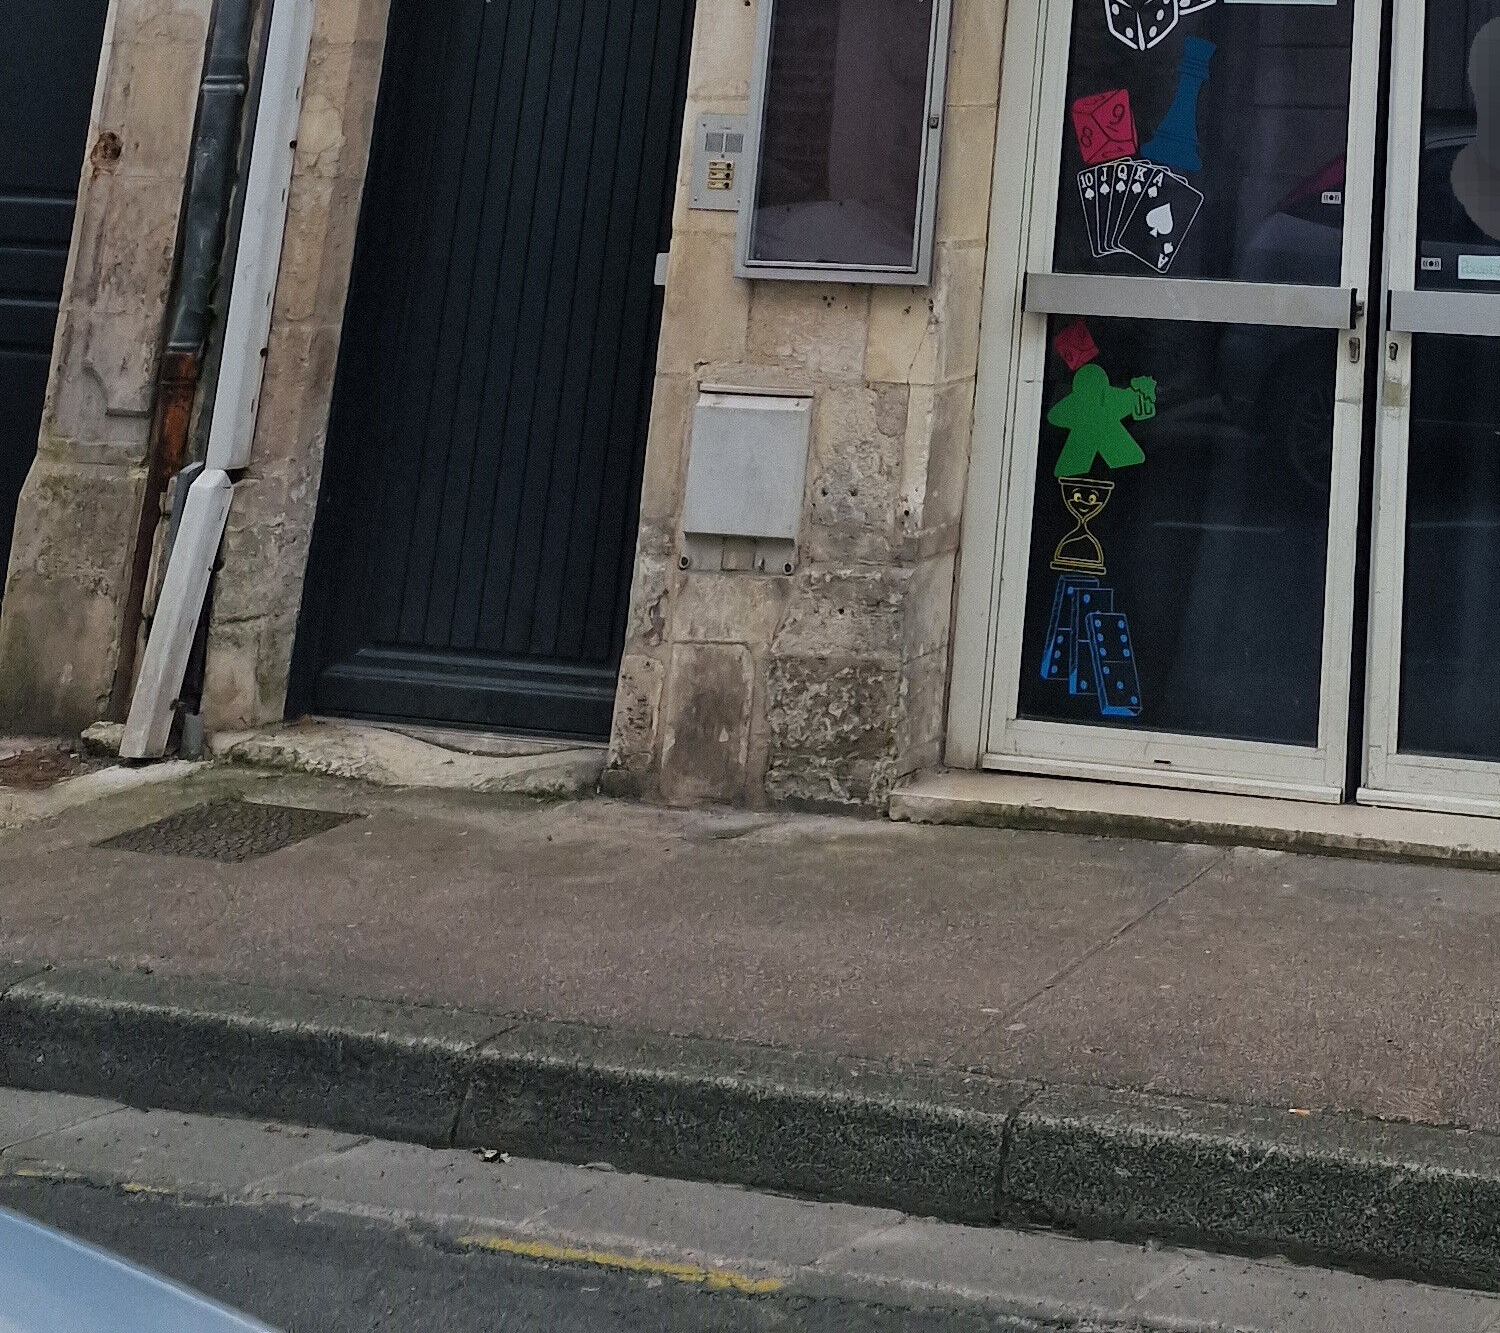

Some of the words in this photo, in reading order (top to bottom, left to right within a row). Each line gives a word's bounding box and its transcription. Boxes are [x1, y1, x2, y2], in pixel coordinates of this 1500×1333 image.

[1080, 173, 1094, 189] 10
[1100, 167, 1108, 182] J
[1117, 164, 1128, 180] Q
[1134, 165, 1148, 181] K
[1152, 172, 1164, 188] A
